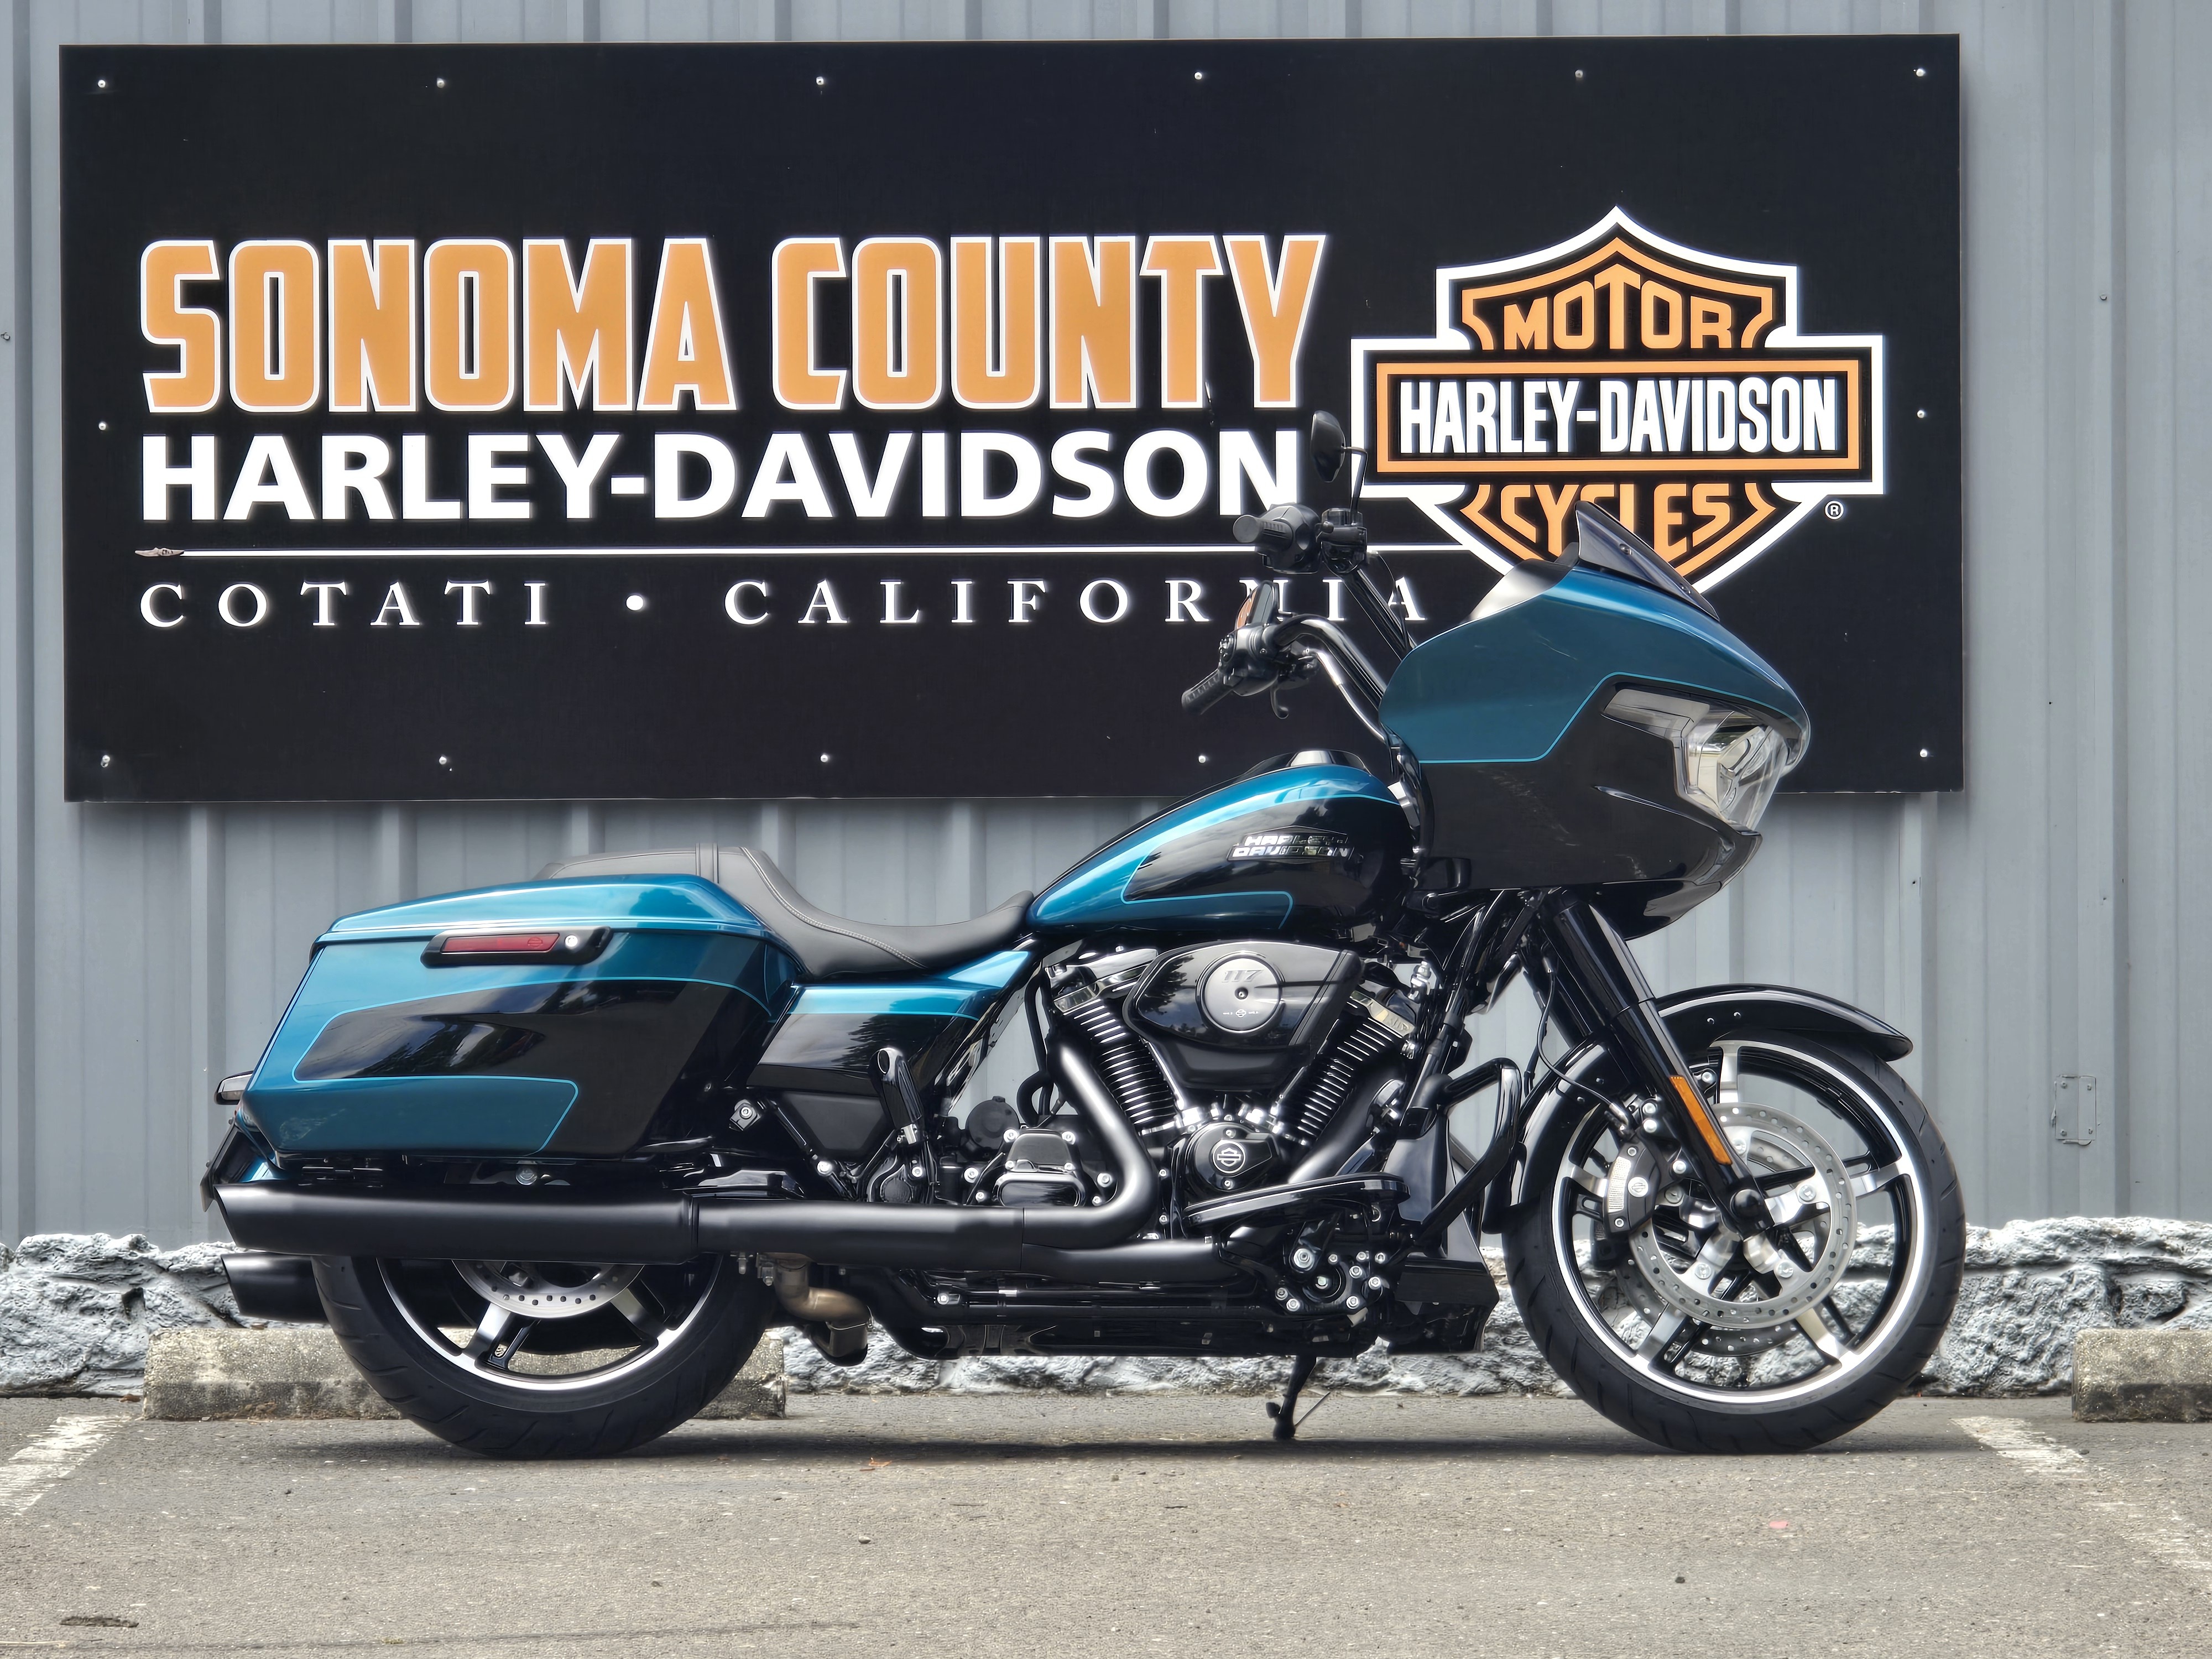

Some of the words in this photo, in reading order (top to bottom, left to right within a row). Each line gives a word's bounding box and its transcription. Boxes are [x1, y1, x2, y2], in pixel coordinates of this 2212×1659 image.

[140, 238, 737, 413] SONOMA
[772, 234, 1327, 410] COUNTY
[1504, 264, 1732, 350] MOTOR
[1400, 377, 1837, 453] HARLEY-DAVIDSON
[143, 430, 1297, 520] HARLEY-DAVIDSON
[1501, 483, 1731, 568] CYES
[140, 581, 546, 628] COTATI
[1222, 969, 1265, 983] 117
